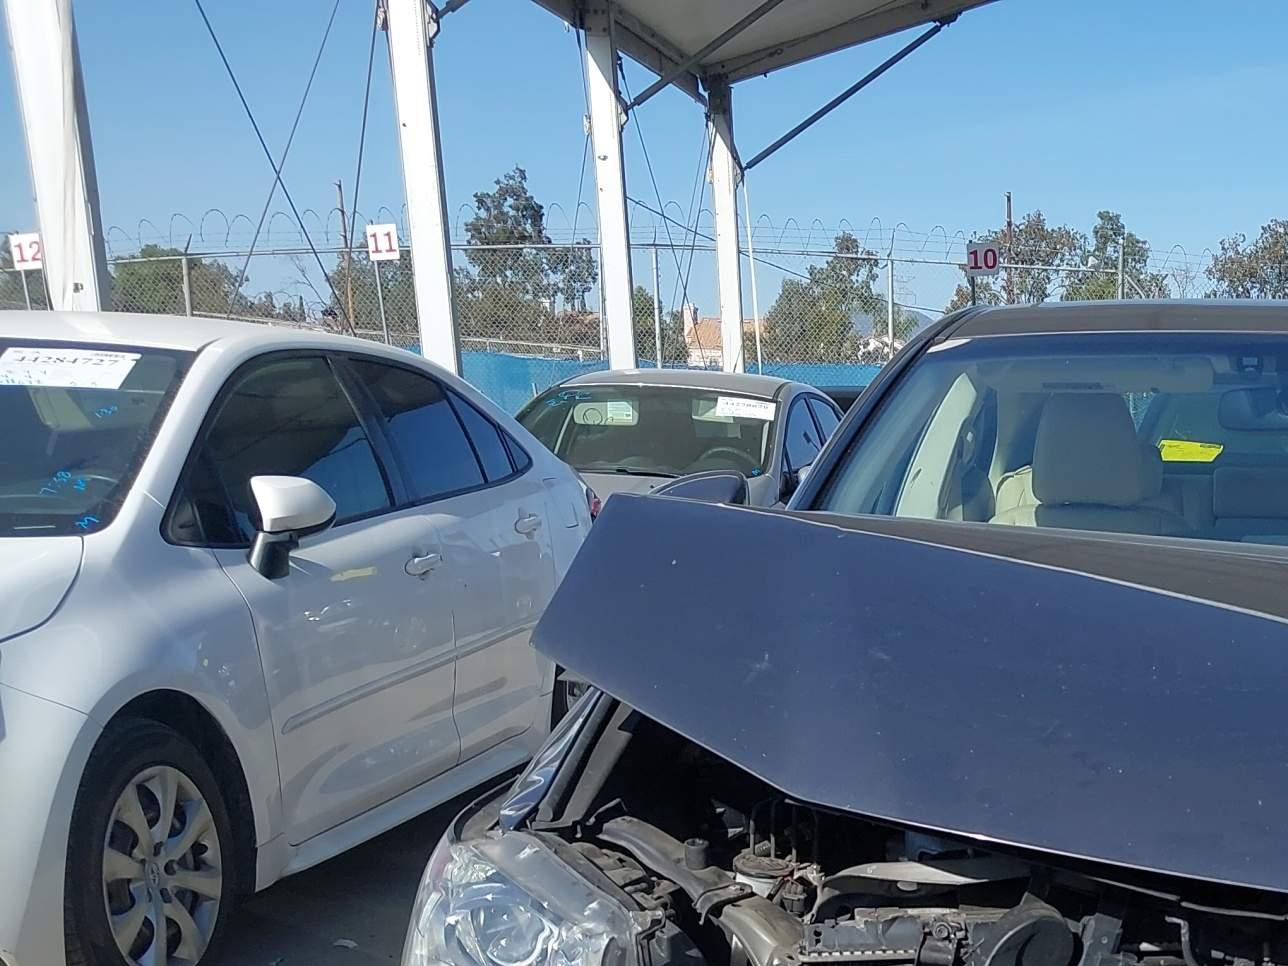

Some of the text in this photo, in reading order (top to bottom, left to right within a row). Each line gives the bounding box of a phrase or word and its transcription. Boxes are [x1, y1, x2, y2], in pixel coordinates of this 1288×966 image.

[14, 240, 42, 263] 12
[370, 231, 397, 254] 11
[969, 248, 998, 270] 10
